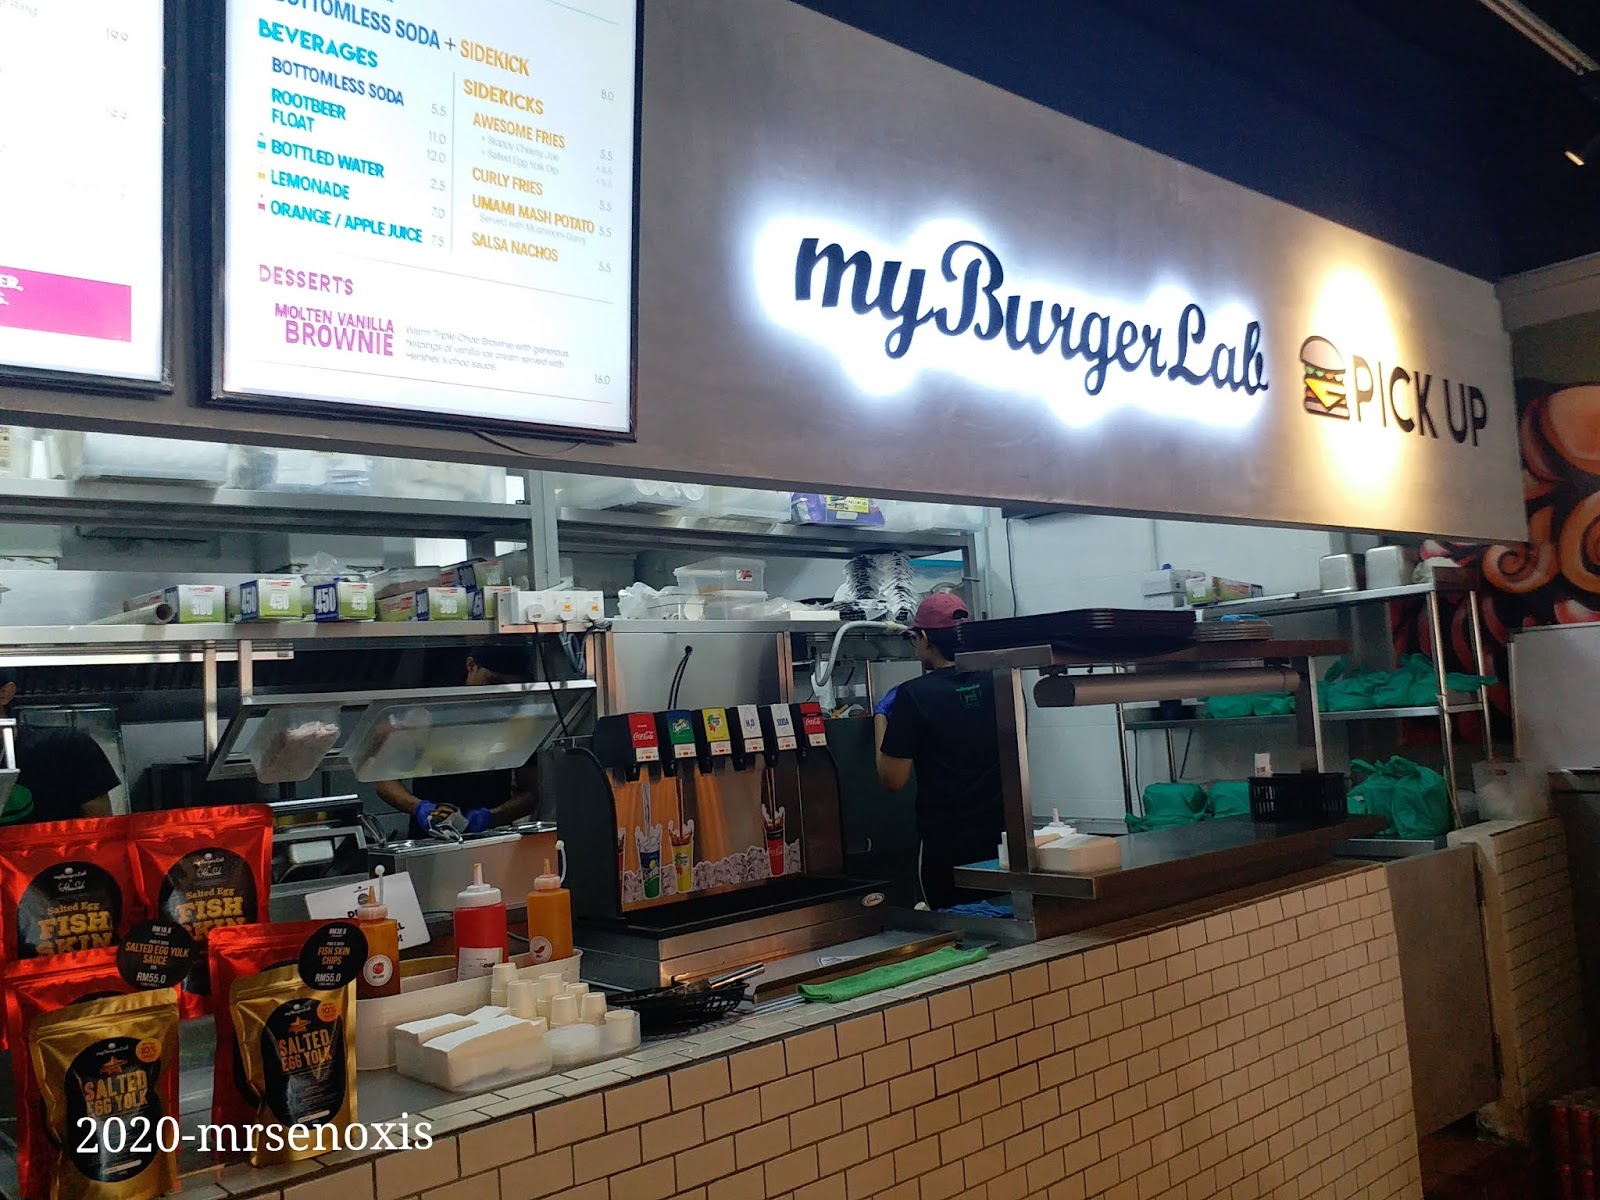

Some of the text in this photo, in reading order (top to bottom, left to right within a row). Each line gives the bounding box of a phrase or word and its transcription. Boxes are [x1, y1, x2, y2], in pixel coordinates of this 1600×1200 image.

[258, 17, 378, 68] BEVERAGES
[395, 18, 440, 49] SODA
[460, 38, 530, 77] SIDEKICK
[272, 56, 447, 117] BOTTOMLESS SODA 5.5
[463, 78, 544, 115] SIDEKICKS
[271, 87, 347, 120] ROOTBEER
[271, 108, 315, 132] FLOAT
[473, 112, 533, 141] AWESOME
[535, 129, 565, 149] FRIES
[271, 138, 335, 167] BOTTLED
[337, 154, 385, 179] WATER
[271, 169, 350, 200] LEMONADE
[472, 167, 510, 188] CURLY
[512, 175, 544, 197] FRIES
[270, 200, 332, 226] ORANGE
[344, 215, 386, 236] APPLE
[387, 223, 424, 244] JUICE
[472, 193, 515, 216] UMAMI
[518, 203, 551, 225] MASH
[554, 212, 595, 234] POTATO
[471, 231, 509, 253] SALSA
[511, 239, 558, 262] NACHOS
[259, 264, 354, 296] DESSERTS
[275, 303, 395, 334] MOLTEN VANILLA
[794, 238, 1269, 396] myBurgerLab
[286, 320, 394, 357] BROWNIE
[1353, 355, 1488, 447] PICK UP
[192, 598, 213, 616] 300
[241, 585, 257, 614] 450
[270, 593, 290, 610] 450
[315, 586, 337, 613] 450
[440, 599, 458, 614] 300
[776, 717, 790, 727] SODA
[47, 901, 100, 915] Salted Egg
[185, 887, 236, 900] Salted Egg
[176, 896, 244, 924] FISH
[38, 911, 110, 940] FISH
[125, 942, 190, 958] SALTED EGG YOLK
[143, 954, 168, 966] SAUCE
[317, 946, 350, 956] FISH SKIN
[321, 955, 342, 965] CHIPS
[136, 971, 166, 984] RM55.0
[314, 972, 342, 983] RM55.0
[277, 1028, 330, 1057] SALTED
[281, 1044, 333, 1072] EGG YOLK
[84, 1069, 148, 1101] SALTED
